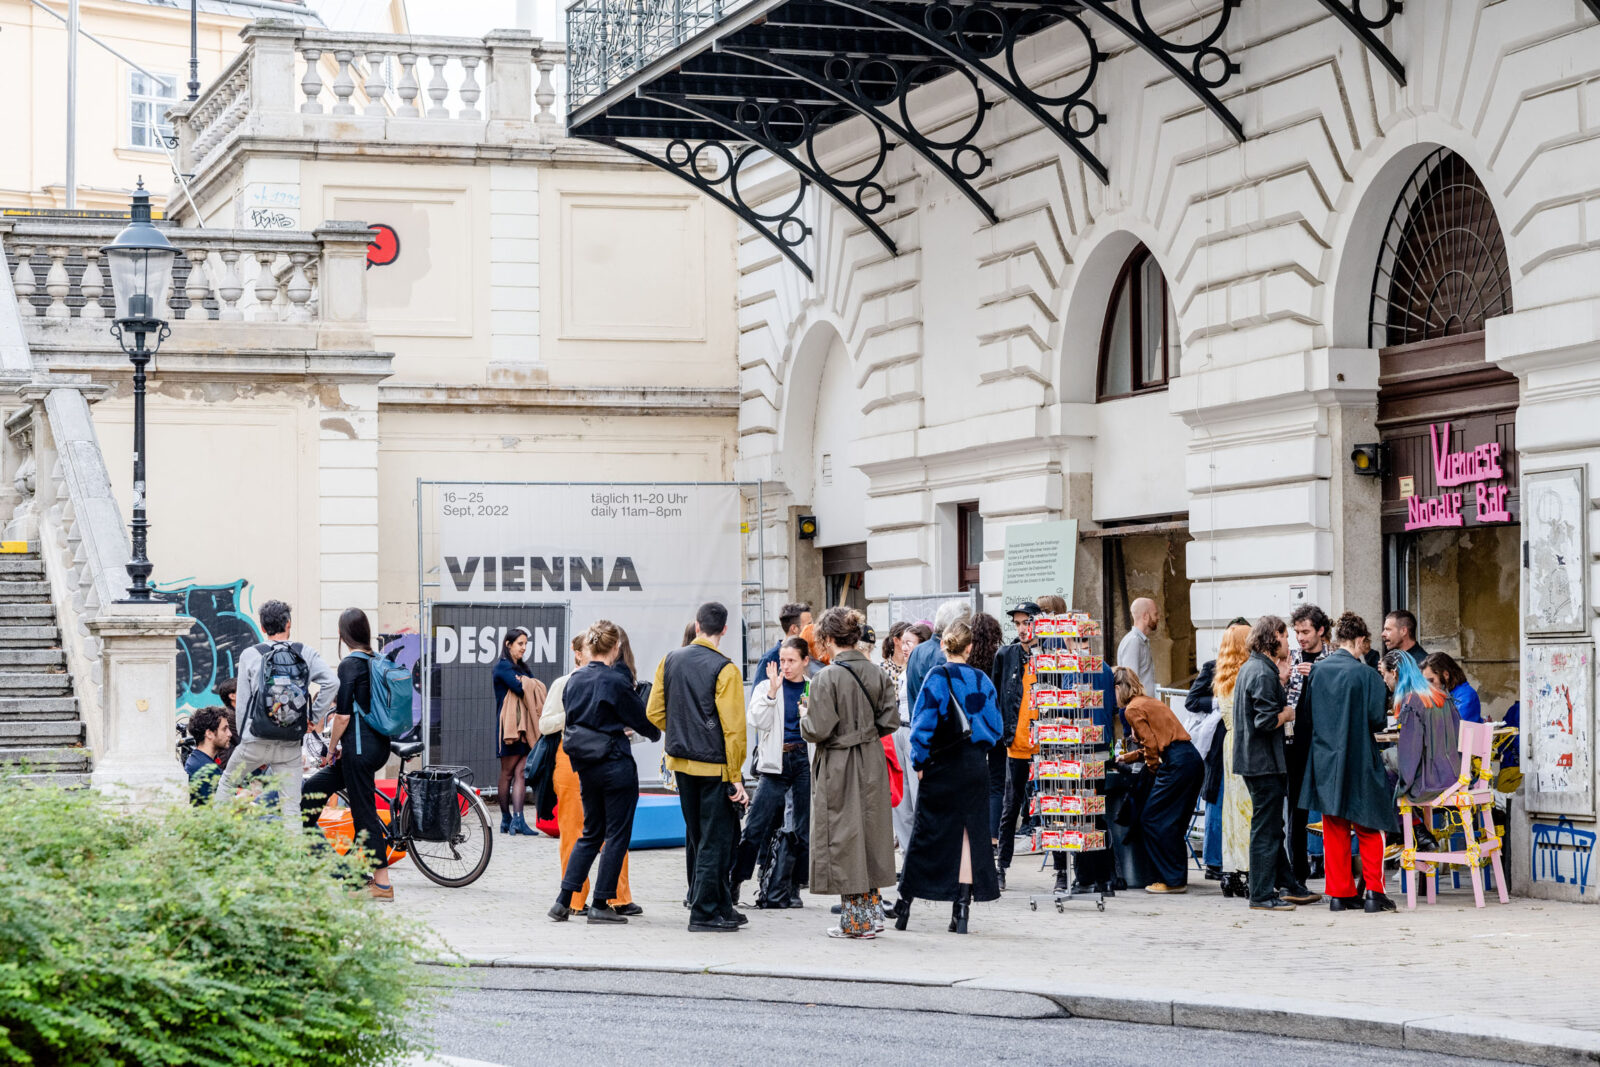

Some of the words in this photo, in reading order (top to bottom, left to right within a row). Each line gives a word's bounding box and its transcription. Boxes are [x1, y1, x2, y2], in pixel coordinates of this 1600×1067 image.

[591, 493, 630, 505] täglich
[667, 493, 688, 504] Uhr
[1476, 482, 1511, 522] Bar
[478, 505, 509, 516] 2022
[591, 506, 618, 518] daily
[444, 556, 643, 591] VIENNA
